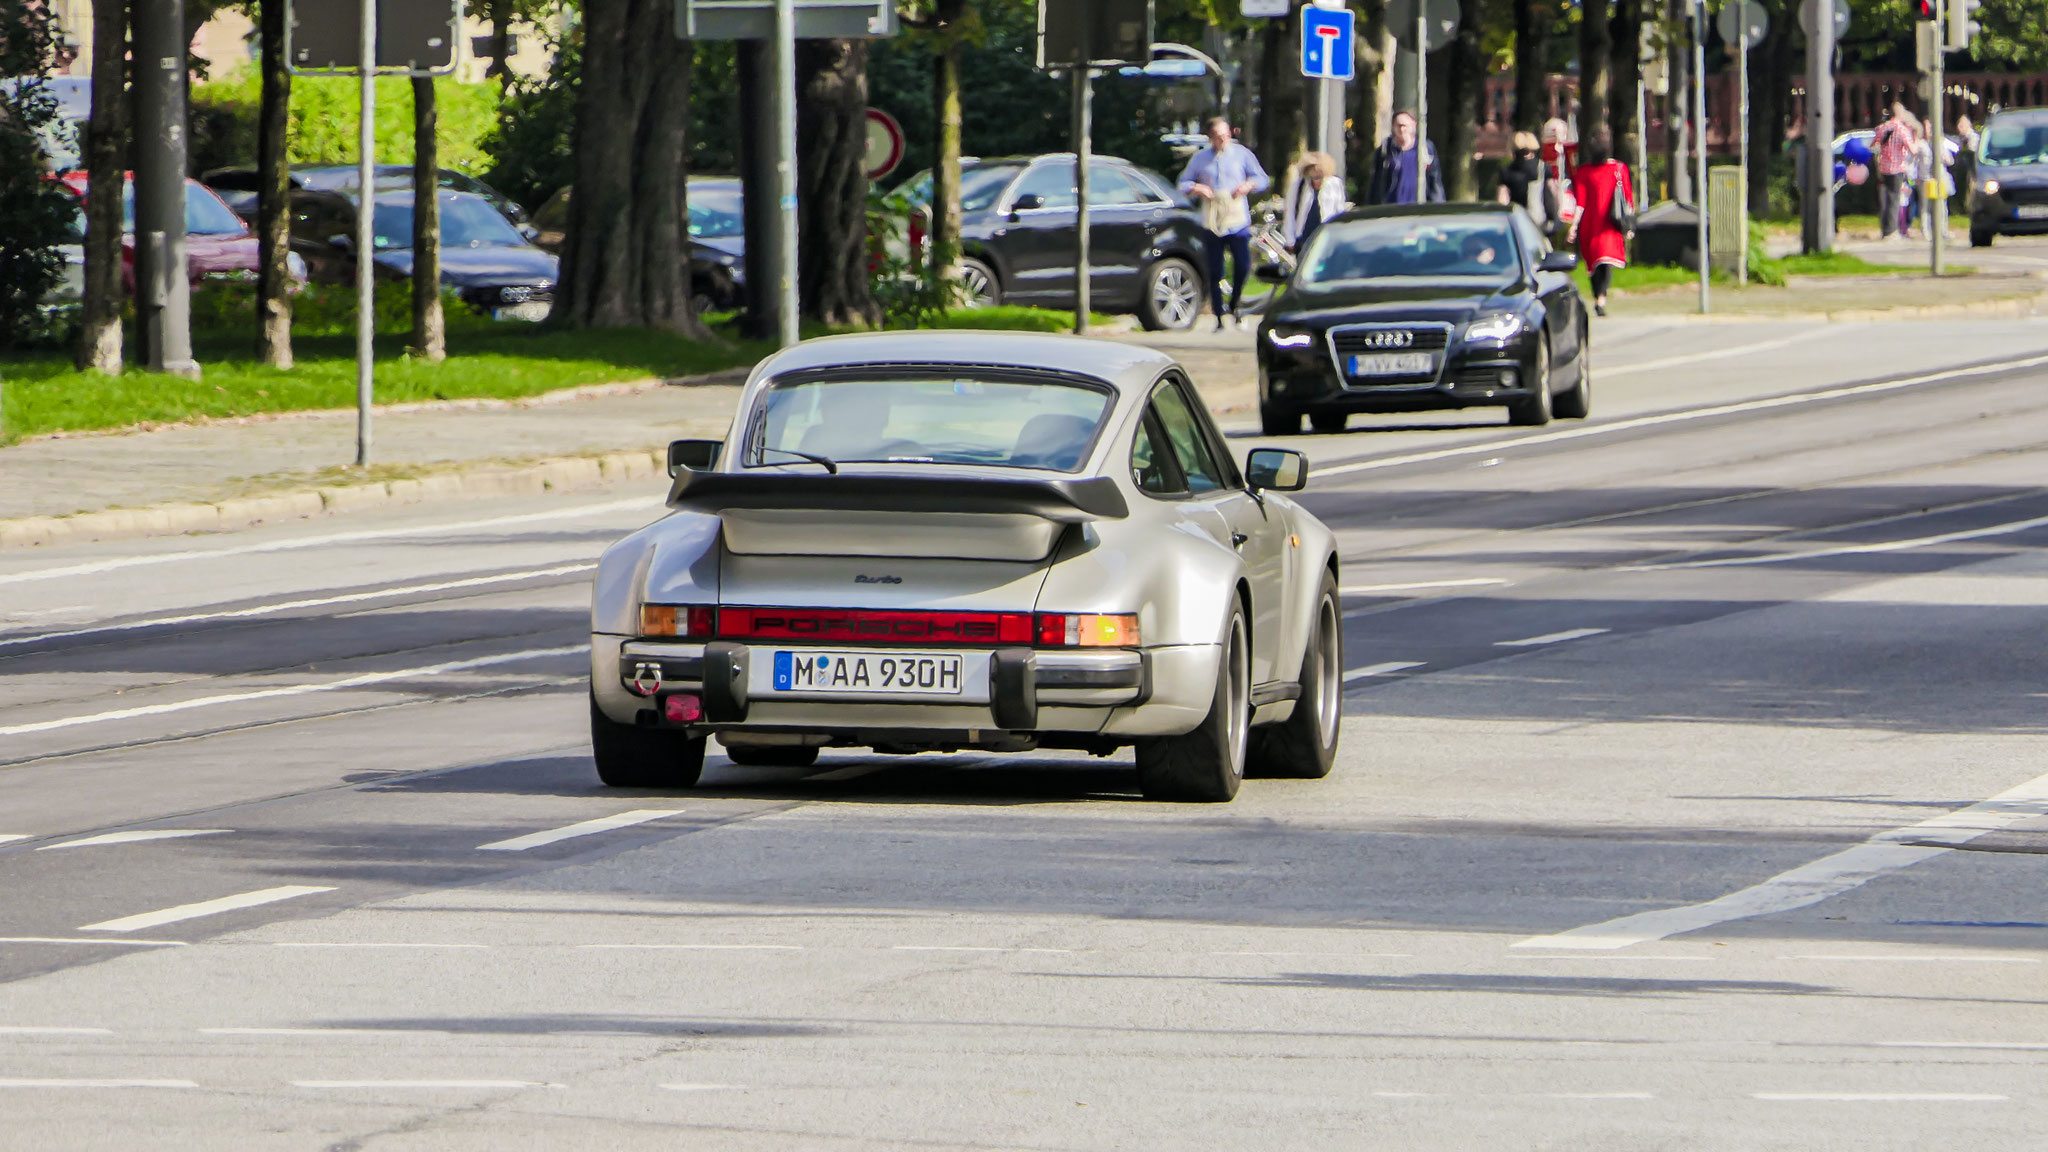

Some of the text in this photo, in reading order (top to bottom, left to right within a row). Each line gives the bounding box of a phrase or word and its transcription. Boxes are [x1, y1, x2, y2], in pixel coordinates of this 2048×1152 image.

[855, 574, 902, 584] turbo
[755, 617, 996, 636] PORSCHE
[779, 674, 787, 683] D
[795, 657, 958, 688] M AA 930H
